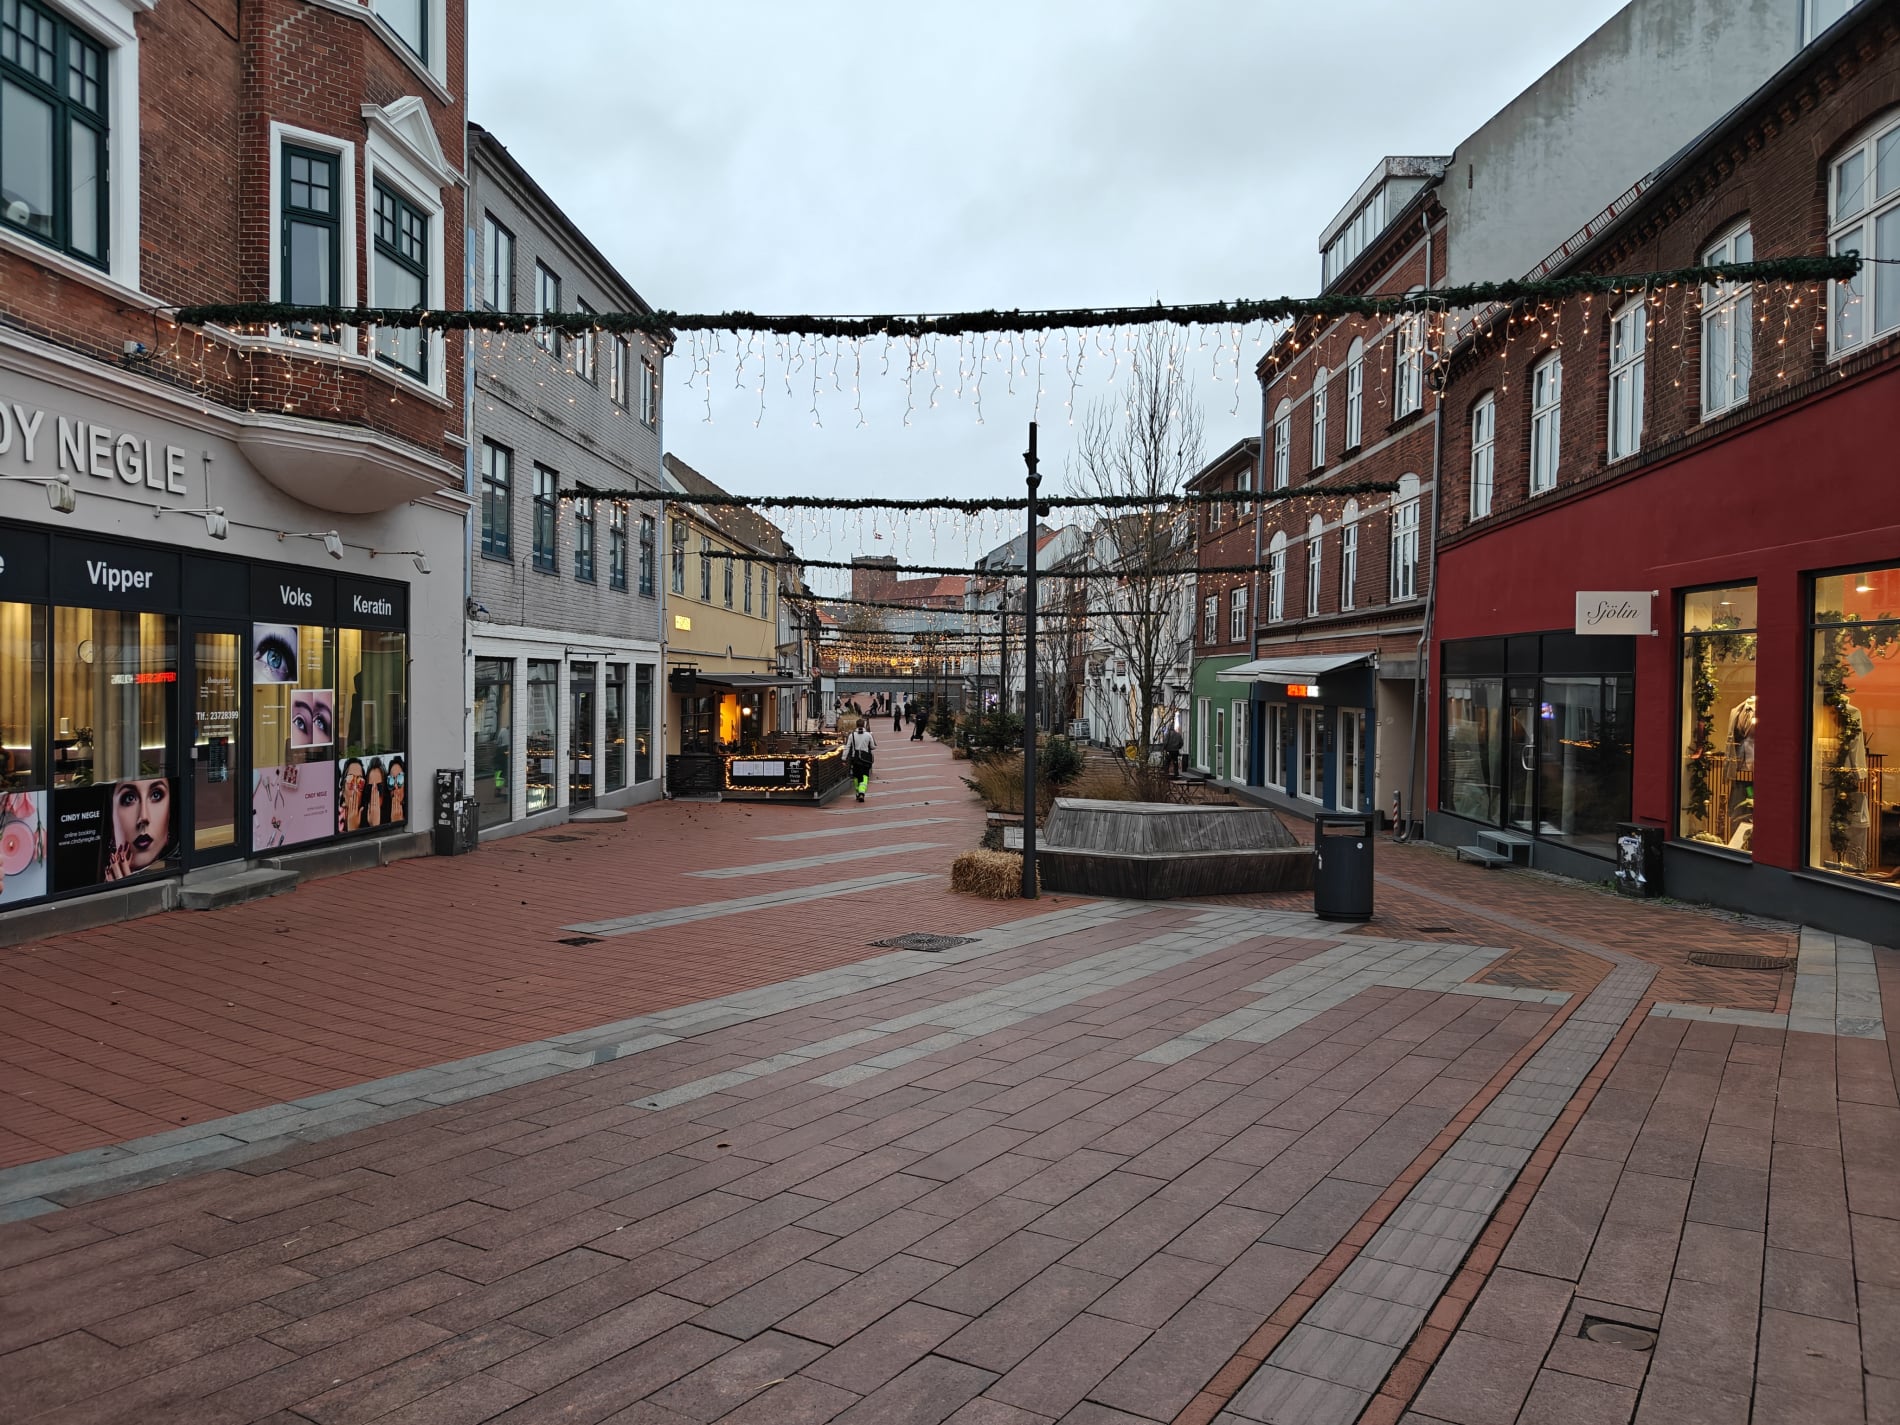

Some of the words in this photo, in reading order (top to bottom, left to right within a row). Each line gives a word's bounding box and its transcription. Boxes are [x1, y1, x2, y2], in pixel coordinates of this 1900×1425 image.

[58, 416, 188, 495] NEGLE
[86, 560, 153, 592] Vipper
[280, 585, 312, 608] Voks
[353, 594, 392, 616] Keratin
[1587, 600, 1640, 626] Sjölin
[60, 813, 80, 823] CINDY
[81, 810, 100, 820] NEGLE
